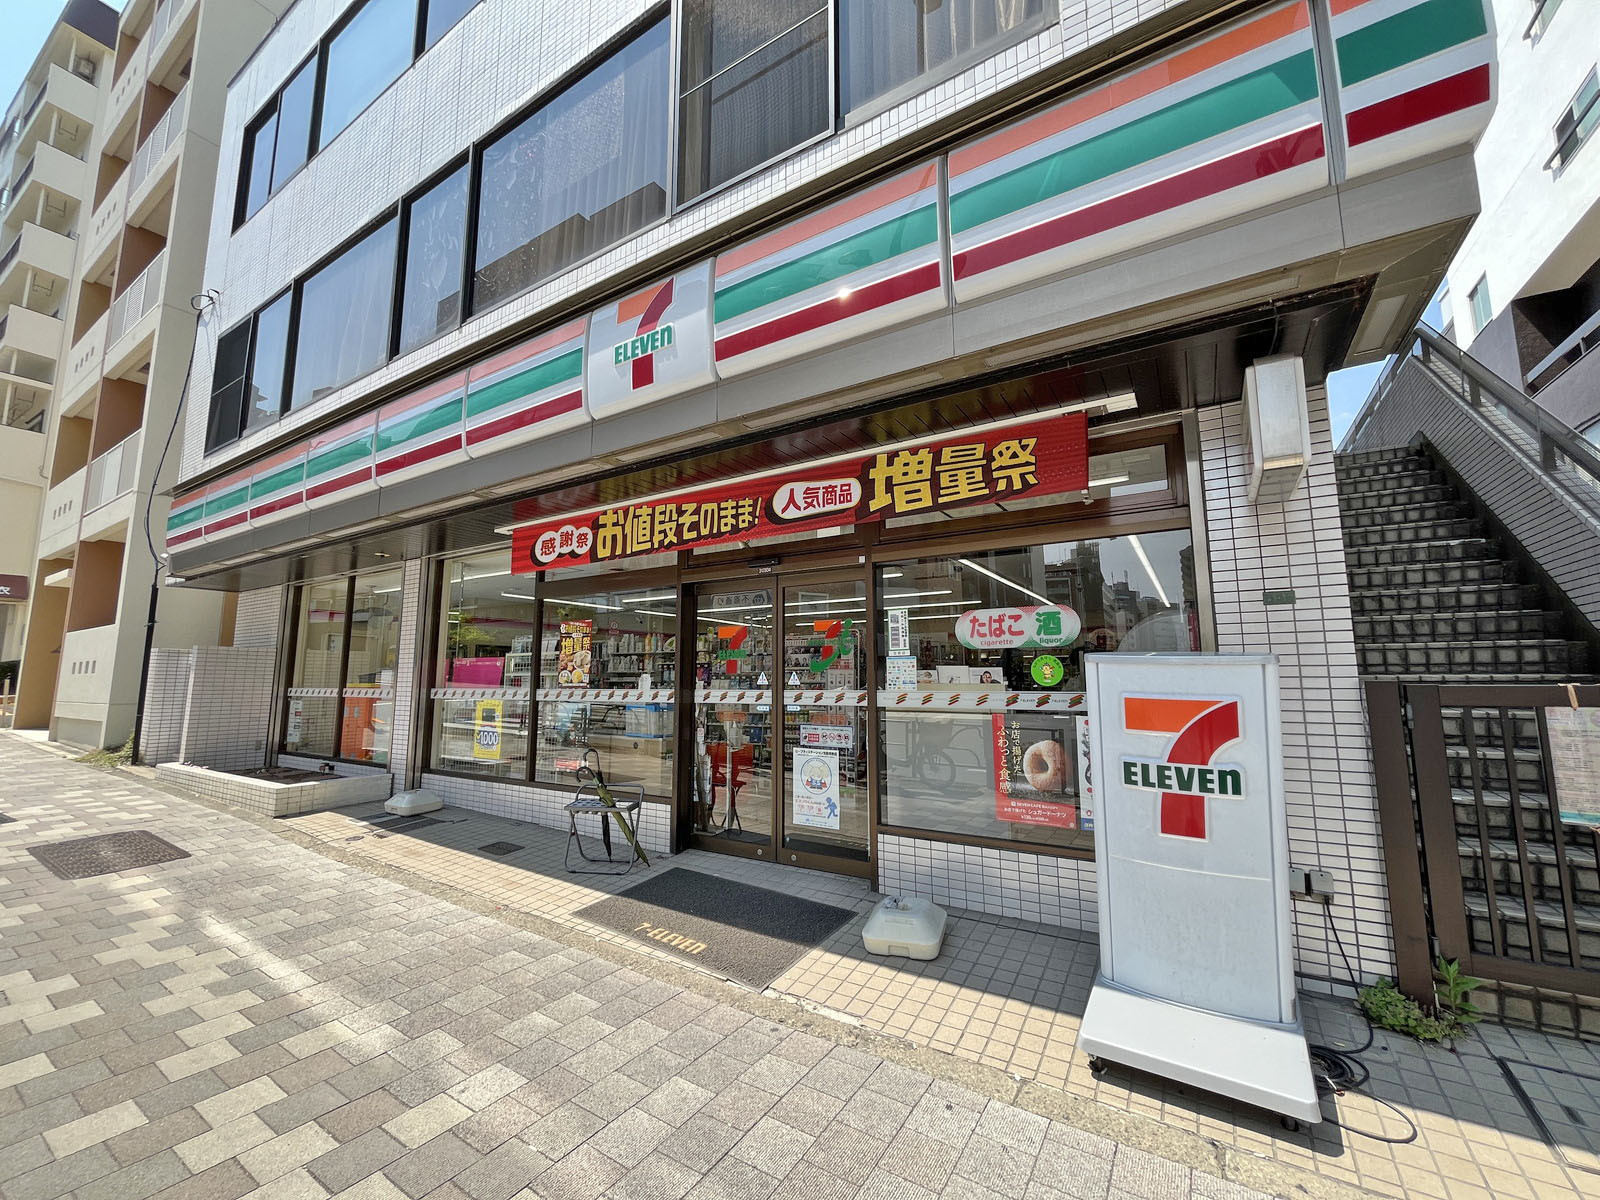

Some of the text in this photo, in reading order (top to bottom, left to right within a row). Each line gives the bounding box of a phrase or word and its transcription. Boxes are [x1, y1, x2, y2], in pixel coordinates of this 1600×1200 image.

[868, 437, 1039, 513] 増量祭
[780, 482, 854, 515] 人気商品
[540, 530, 589, 556] 感謝祭
[969, 611, 1062, 638] たばこ 酒
[1039, 637, 1062, 645] liquor
[480, 731, 498, 745] 1000
[1011, 721, 1022, 774] お店で揚げた
[997, 725, 1012, 794] ふわっと食感
[1028, 809, 1067, 818] シュガードーナツ
